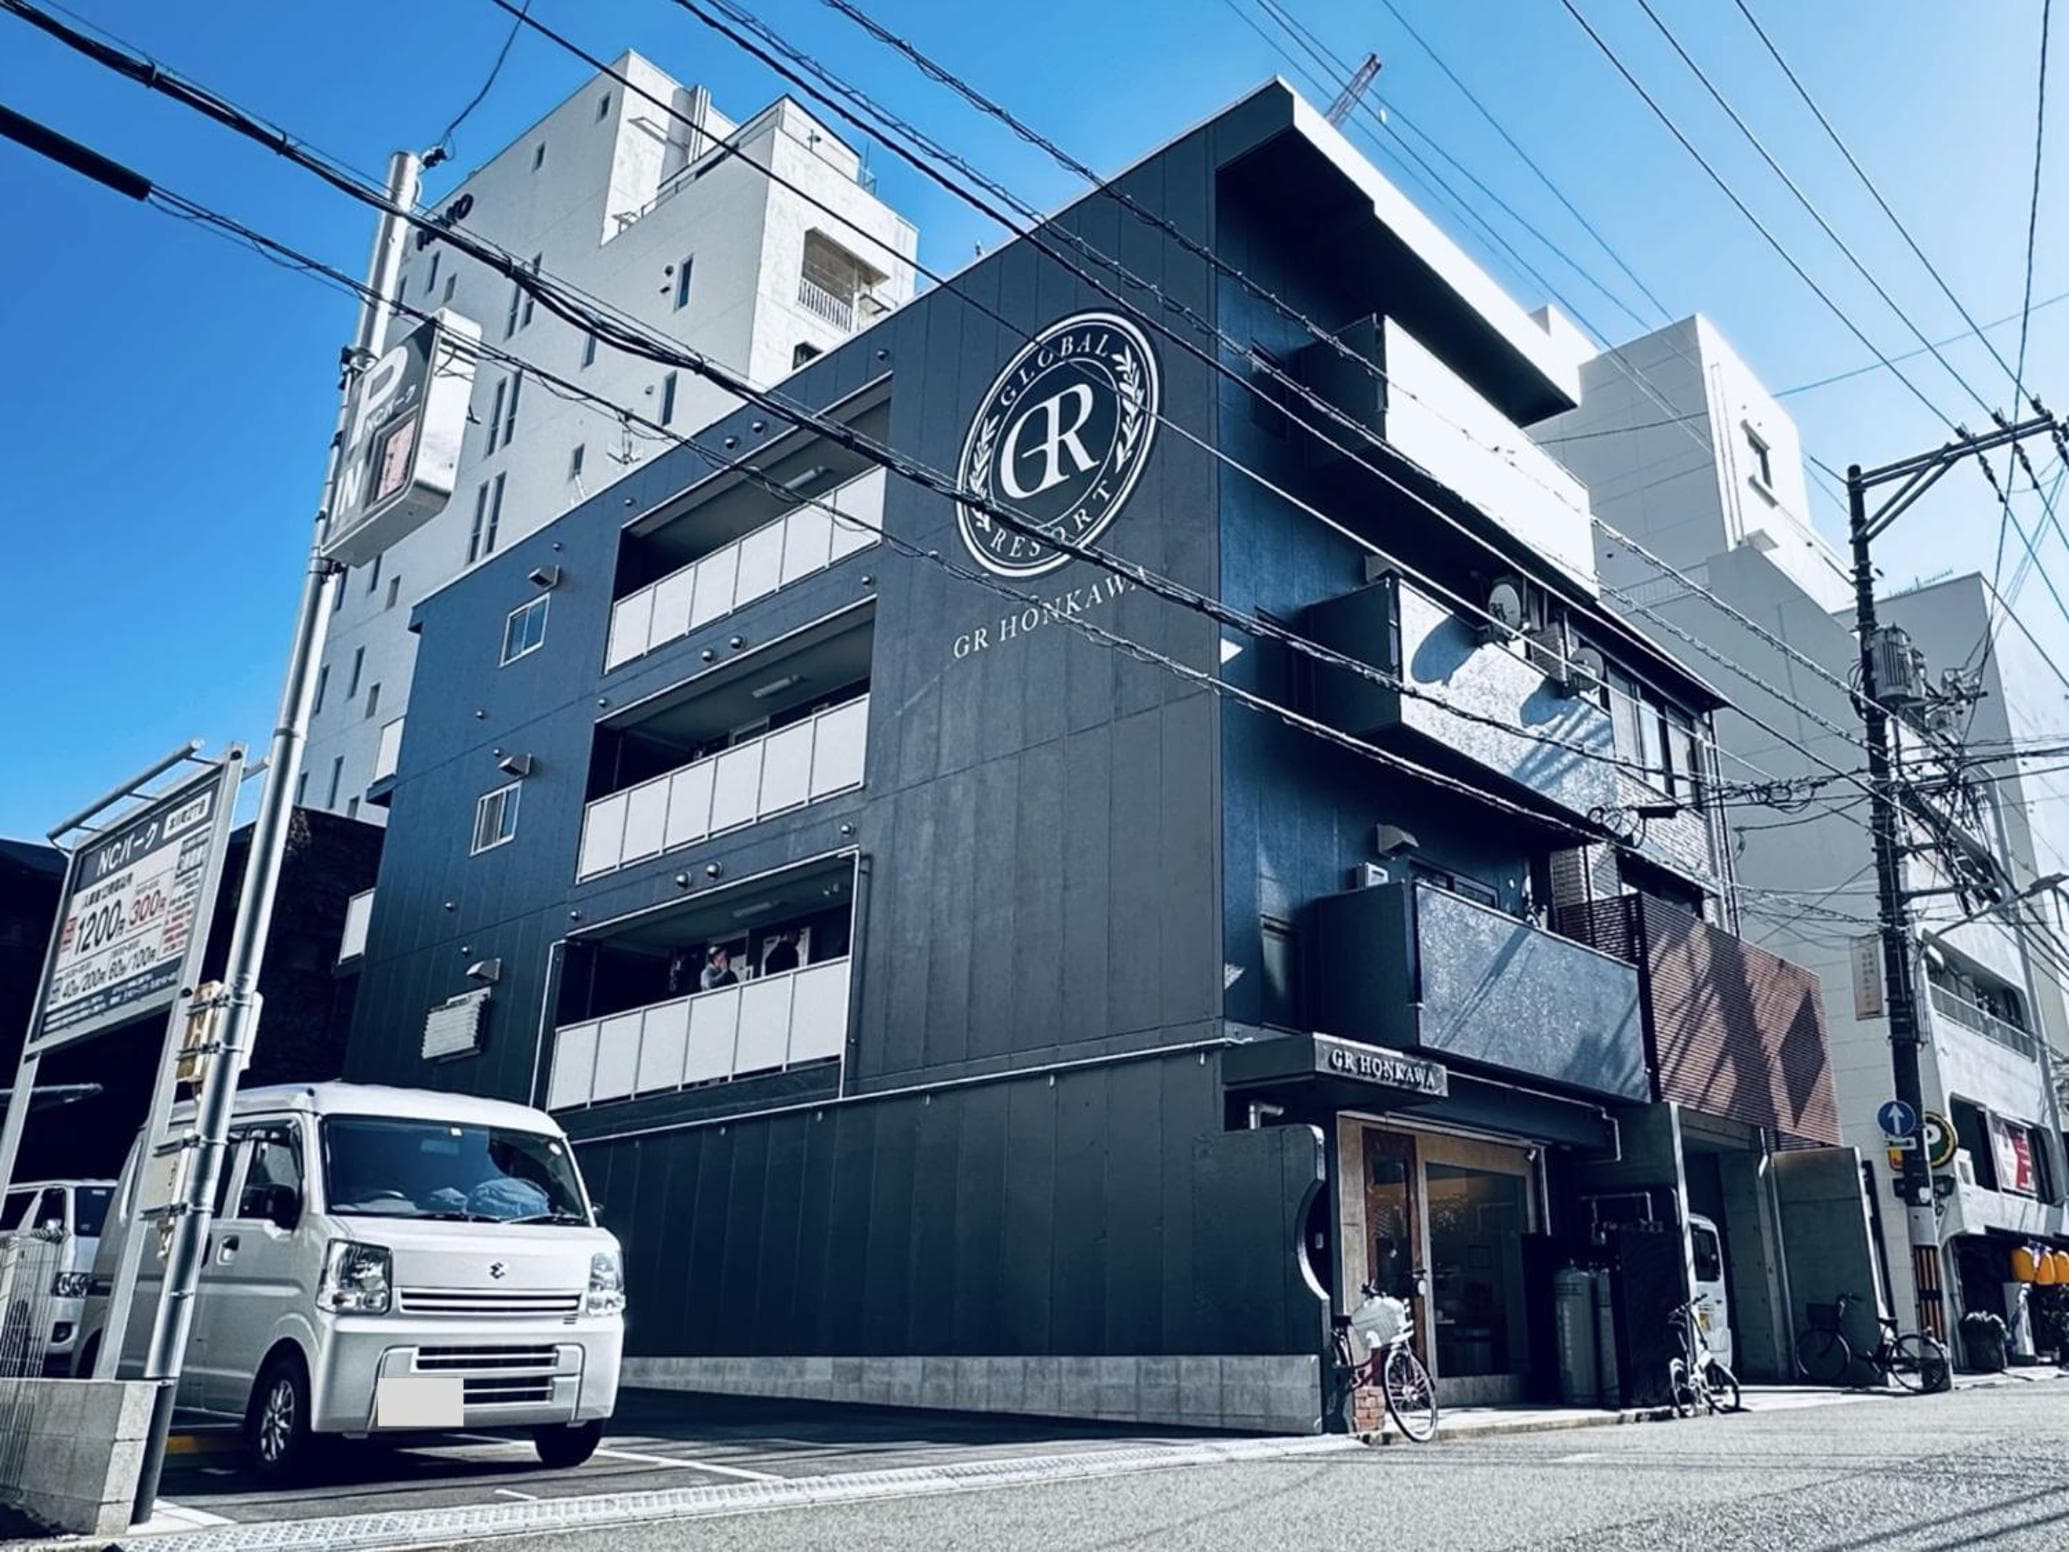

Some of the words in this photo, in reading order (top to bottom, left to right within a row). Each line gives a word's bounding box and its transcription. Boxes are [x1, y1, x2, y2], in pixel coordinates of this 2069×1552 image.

[350, 346, 408, 450] P
[1001, 333, 1109, 407] GLOBAL
[332, 458, 365, 523] IN
[953, 628, 989, 659] GR
[97, 822, 159, 877] NCパーク
[1332, 1048, 1357, 1075] GR
[1360, 1055, 1436, 1090] HONKAWA
